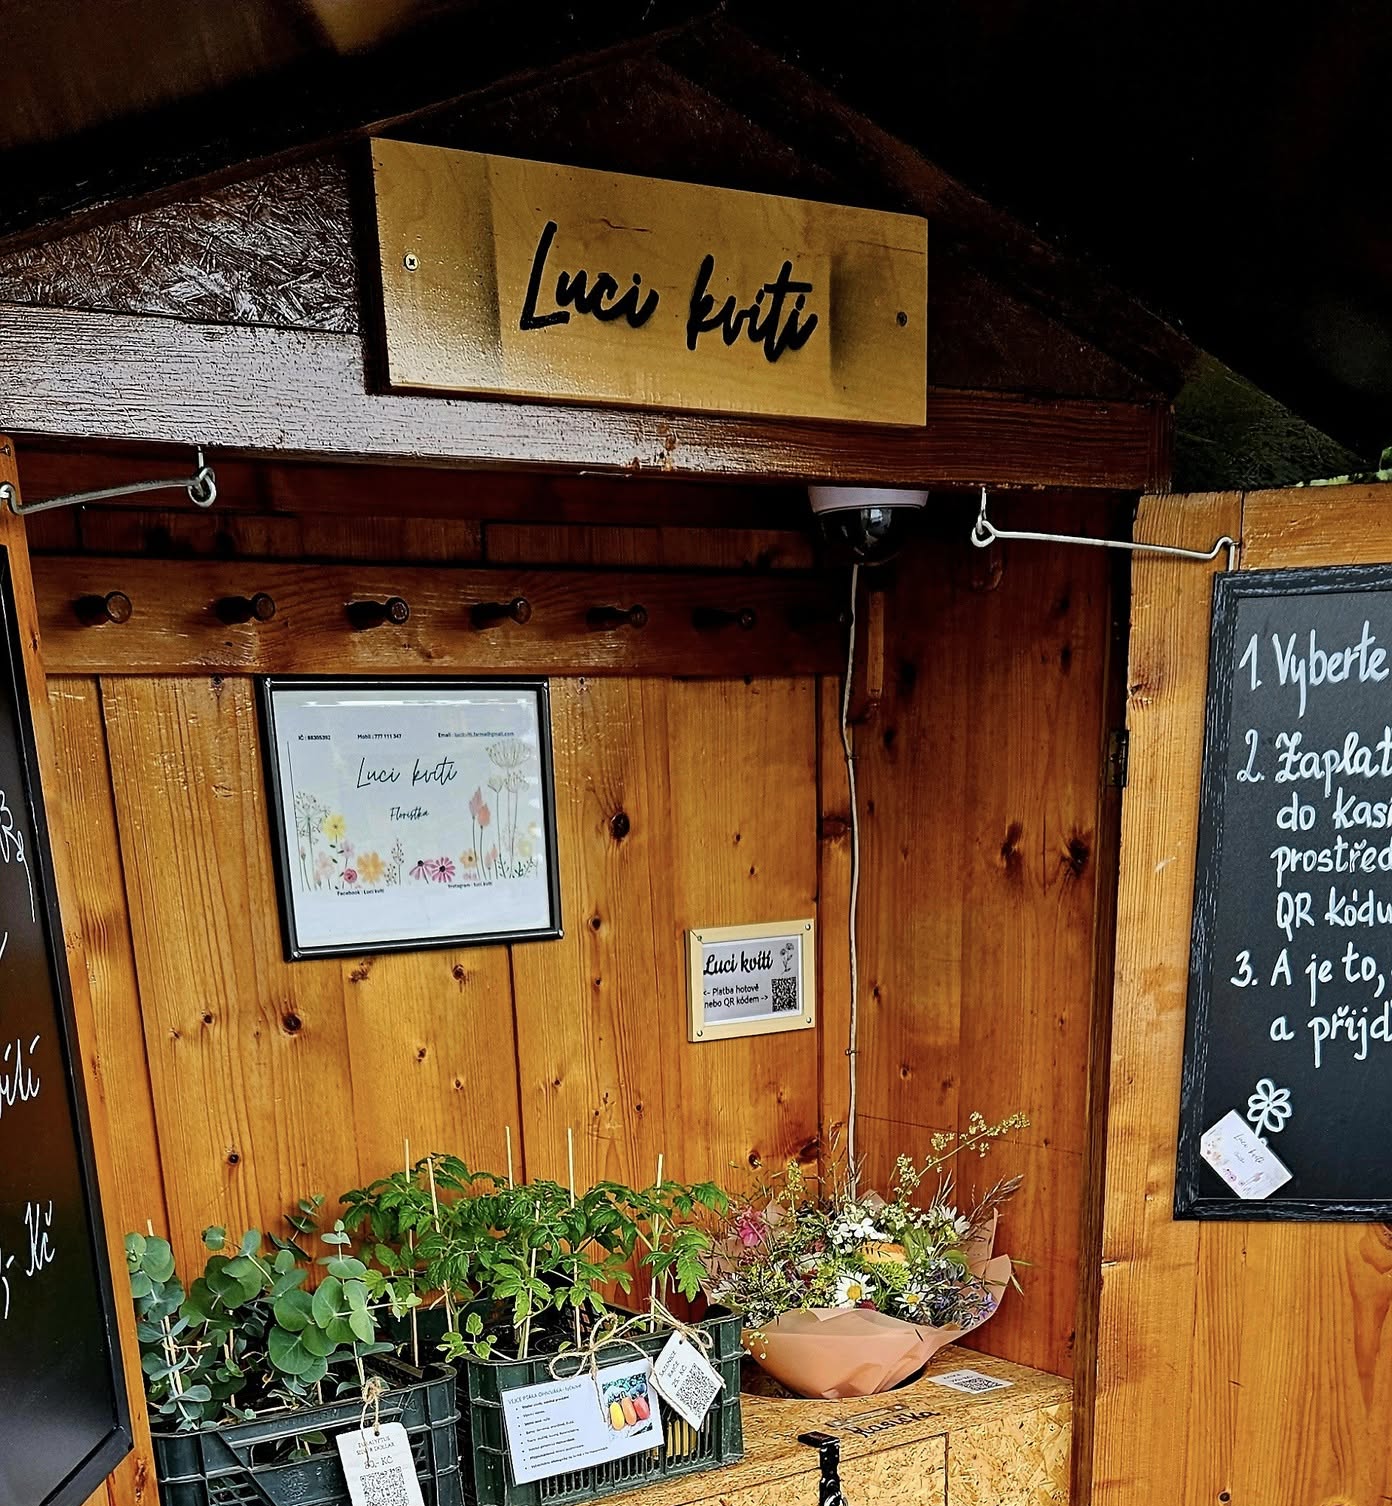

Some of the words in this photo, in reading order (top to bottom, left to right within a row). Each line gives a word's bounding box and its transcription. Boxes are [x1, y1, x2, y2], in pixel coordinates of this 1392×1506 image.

[519, 220, 659, 331] Luci
[1238, 633, 1262, 691] 1.
[1272, 620, 1390, 719] Vyberte
[357, 757, 401, 788] Luci
[1237, 728, 1265, 782] 2.
[390, 806, 429, 821] Floristka
[1276, 791, 1316, 831] do
[1276, 891, 1315, 942] QR
[703, 953, 738, 975] Luci
[1230, 950, 1259, 987] 3.
[1270, 948, 1291, 986] A
[1305, 953, 1333, 1007] je
[1341, 941, 1385, 998] to,
[704, 999, 722, 1009] nebo
[724, 998, 735, 1007] QR
[712, 986, 734, 996] Platba
[735, 983, 759, 994] hotově
[1270, 1015, 1295, 1041] a
[25, 1200, 55, 1276] Kč
